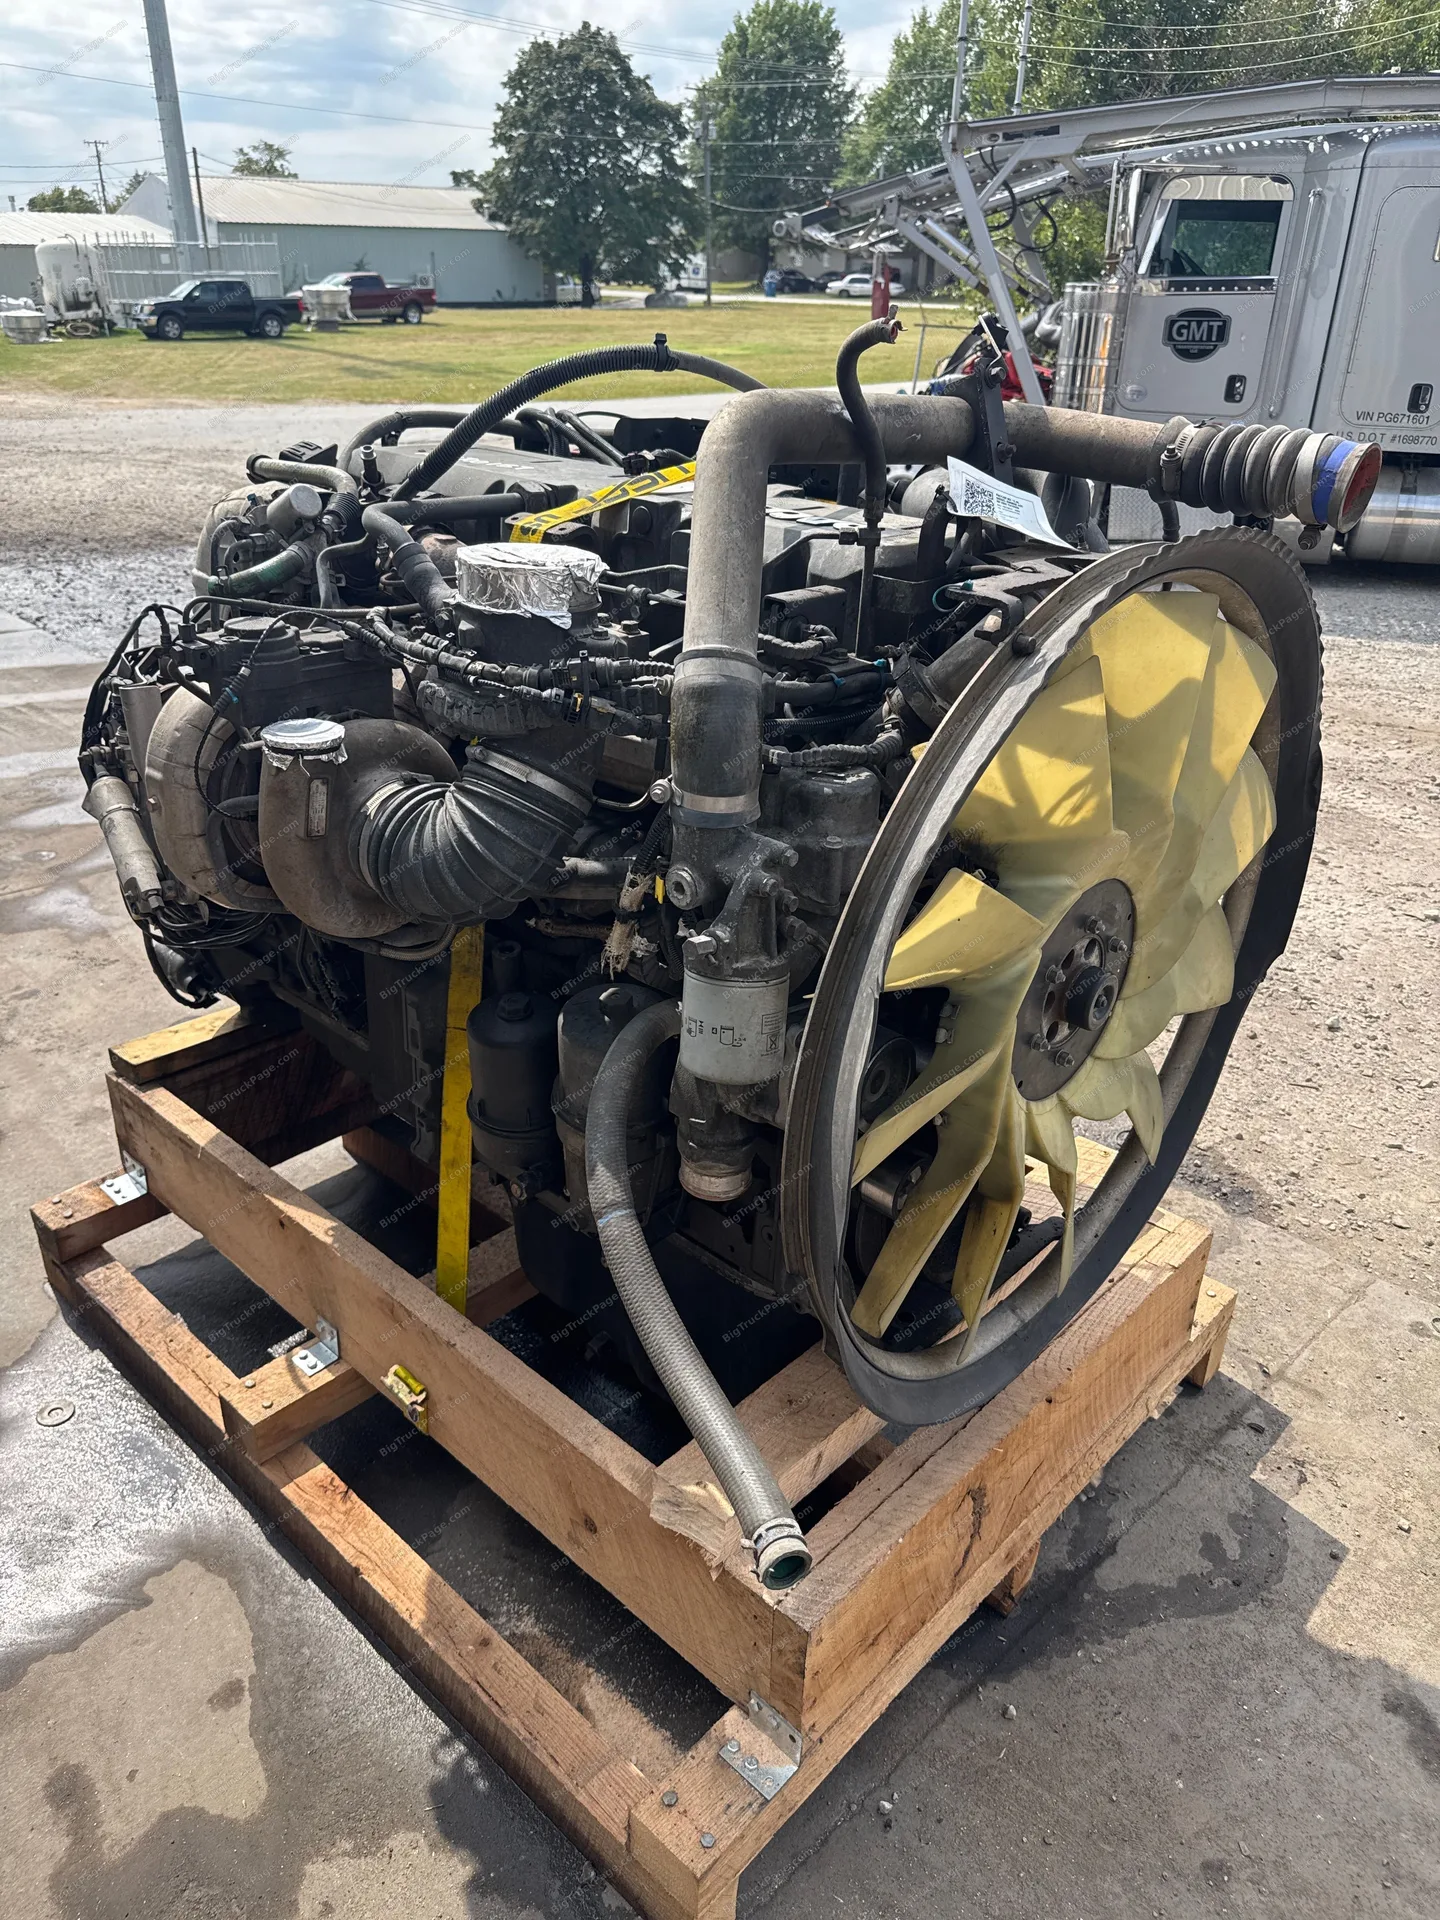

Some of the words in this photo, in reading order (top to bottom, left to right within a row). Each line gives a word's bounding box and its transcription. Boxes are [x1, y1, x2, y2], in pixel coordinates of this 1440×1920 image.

[1171, 320, 1223, 342] GMT
[1356, 410, 1375, 422] VIN
[1376, 412, 1430, 425] PG671601
[1390, 434, 1438, 446] #1698770
